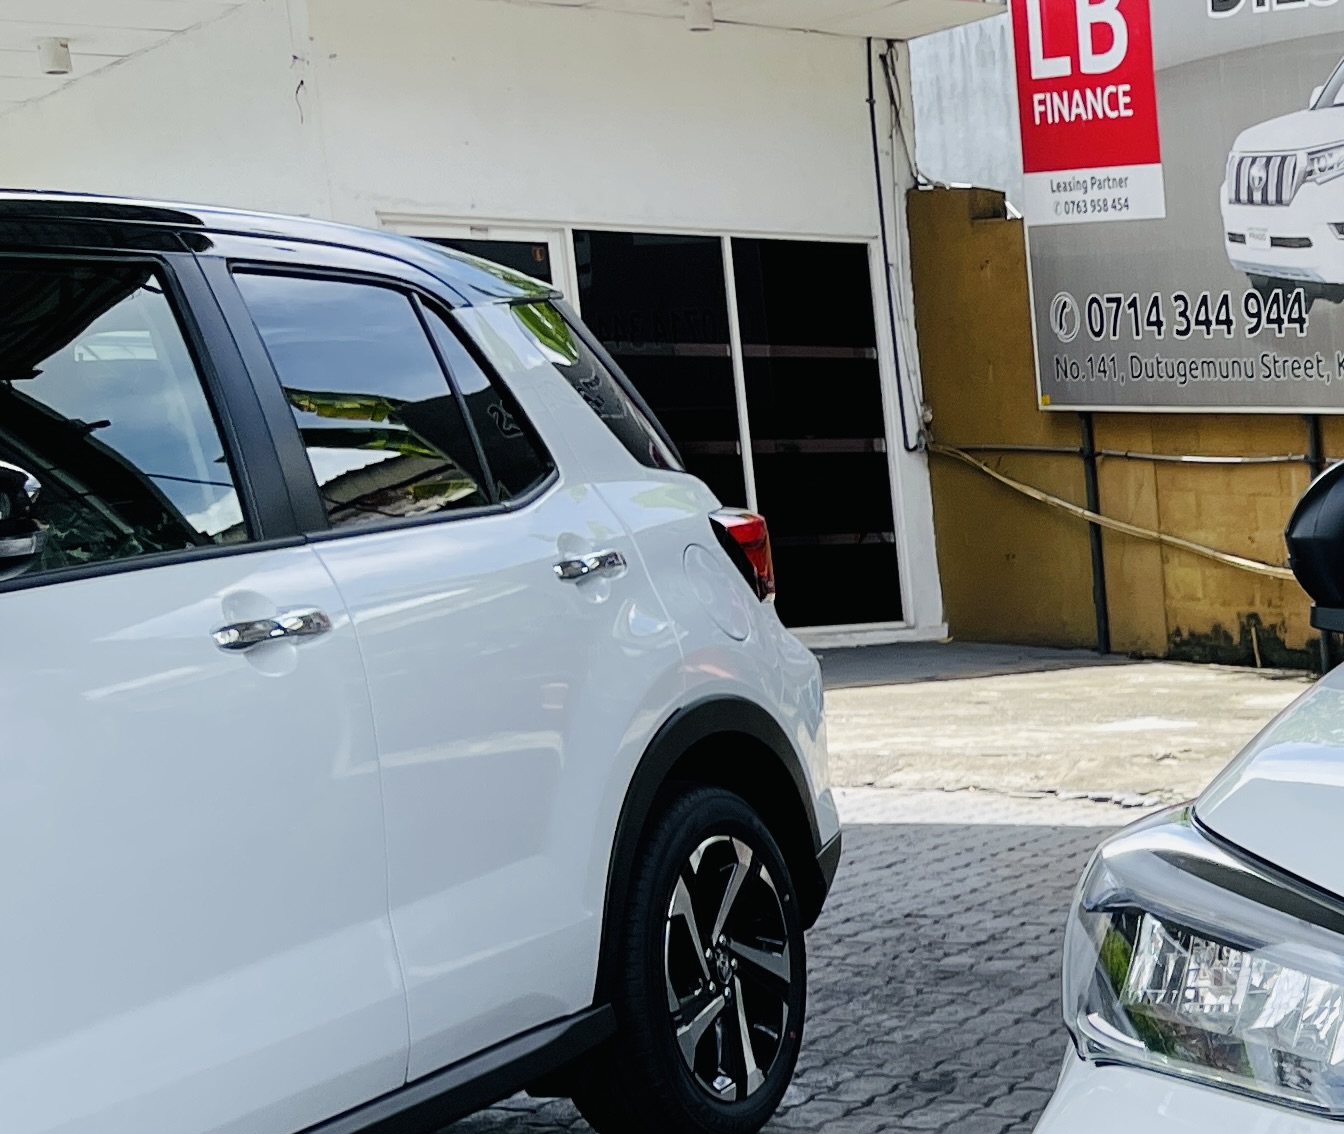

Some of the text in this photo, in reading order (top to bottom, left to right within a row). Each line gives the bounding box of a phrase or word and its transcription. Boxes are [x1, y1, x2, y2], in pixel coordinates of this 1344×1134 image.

[1027, 0, 1128, 79] LB
[1033, 84, 1133, 125] FINANCE
[1050, 175, 1128, 195] Leasing Partner
[1064, 197, 1129, 215] 0763 958 454
[1087, 287, 1308, 341] 0714 344 944
[1054, 354, 1125, 384] No.141,
[1129, 352, 1256, 387] Dutugemunu
[1260, 351, 1331, 383] Street,
